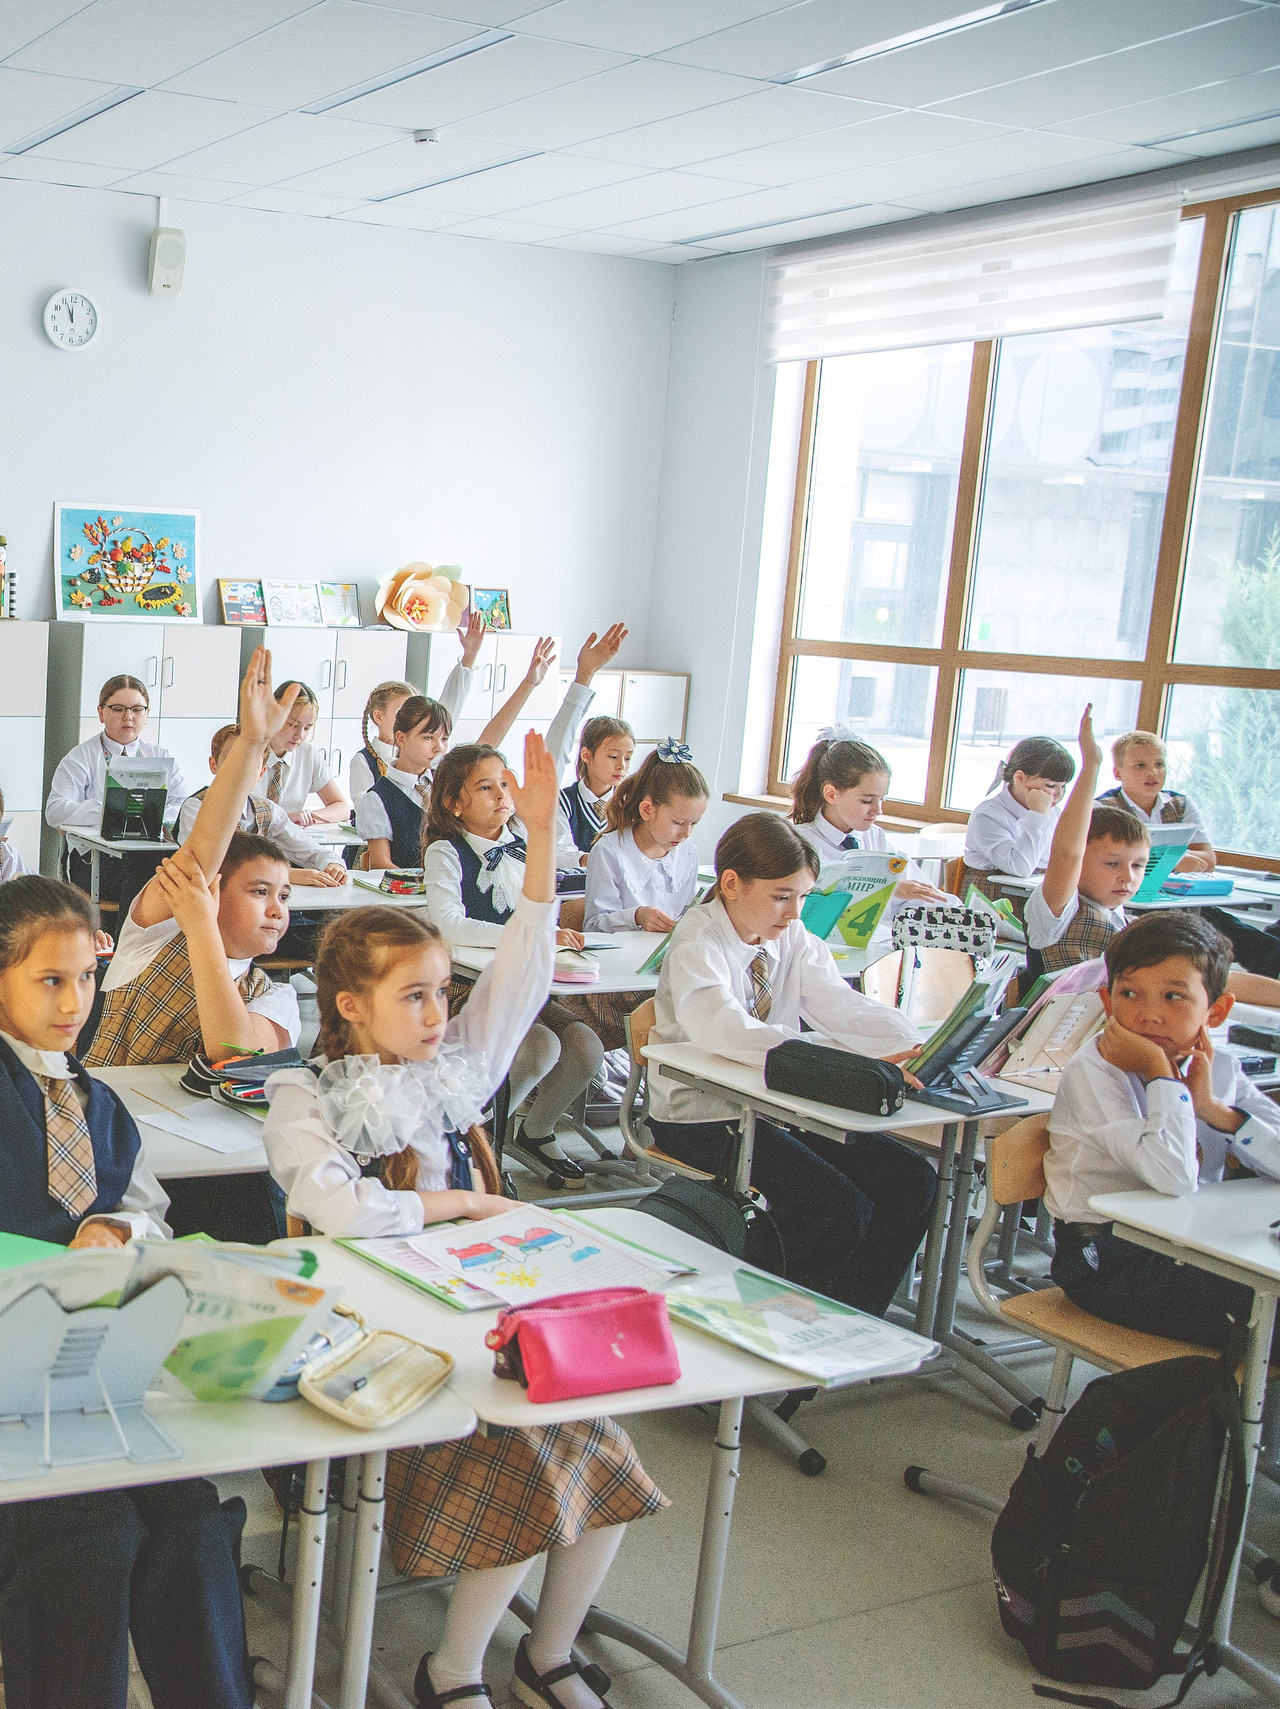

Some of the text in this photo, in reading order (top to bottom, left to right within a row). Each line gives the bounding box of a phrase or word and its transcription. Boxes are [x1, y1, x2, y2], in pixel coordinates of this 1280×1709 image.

[70, 295, 78, 304] 12
[86, 308, 91, 316] 2
[88, 318, 93, 326] 3
[85, 328, 90, 336] 4
[59, 333, 65, 341] 7
[68, 336, 74, 344] 6
[78, 335, 83, 343] 5
[845, 881, 875, 893] МИР
[847, 902, 881, 937] 4
